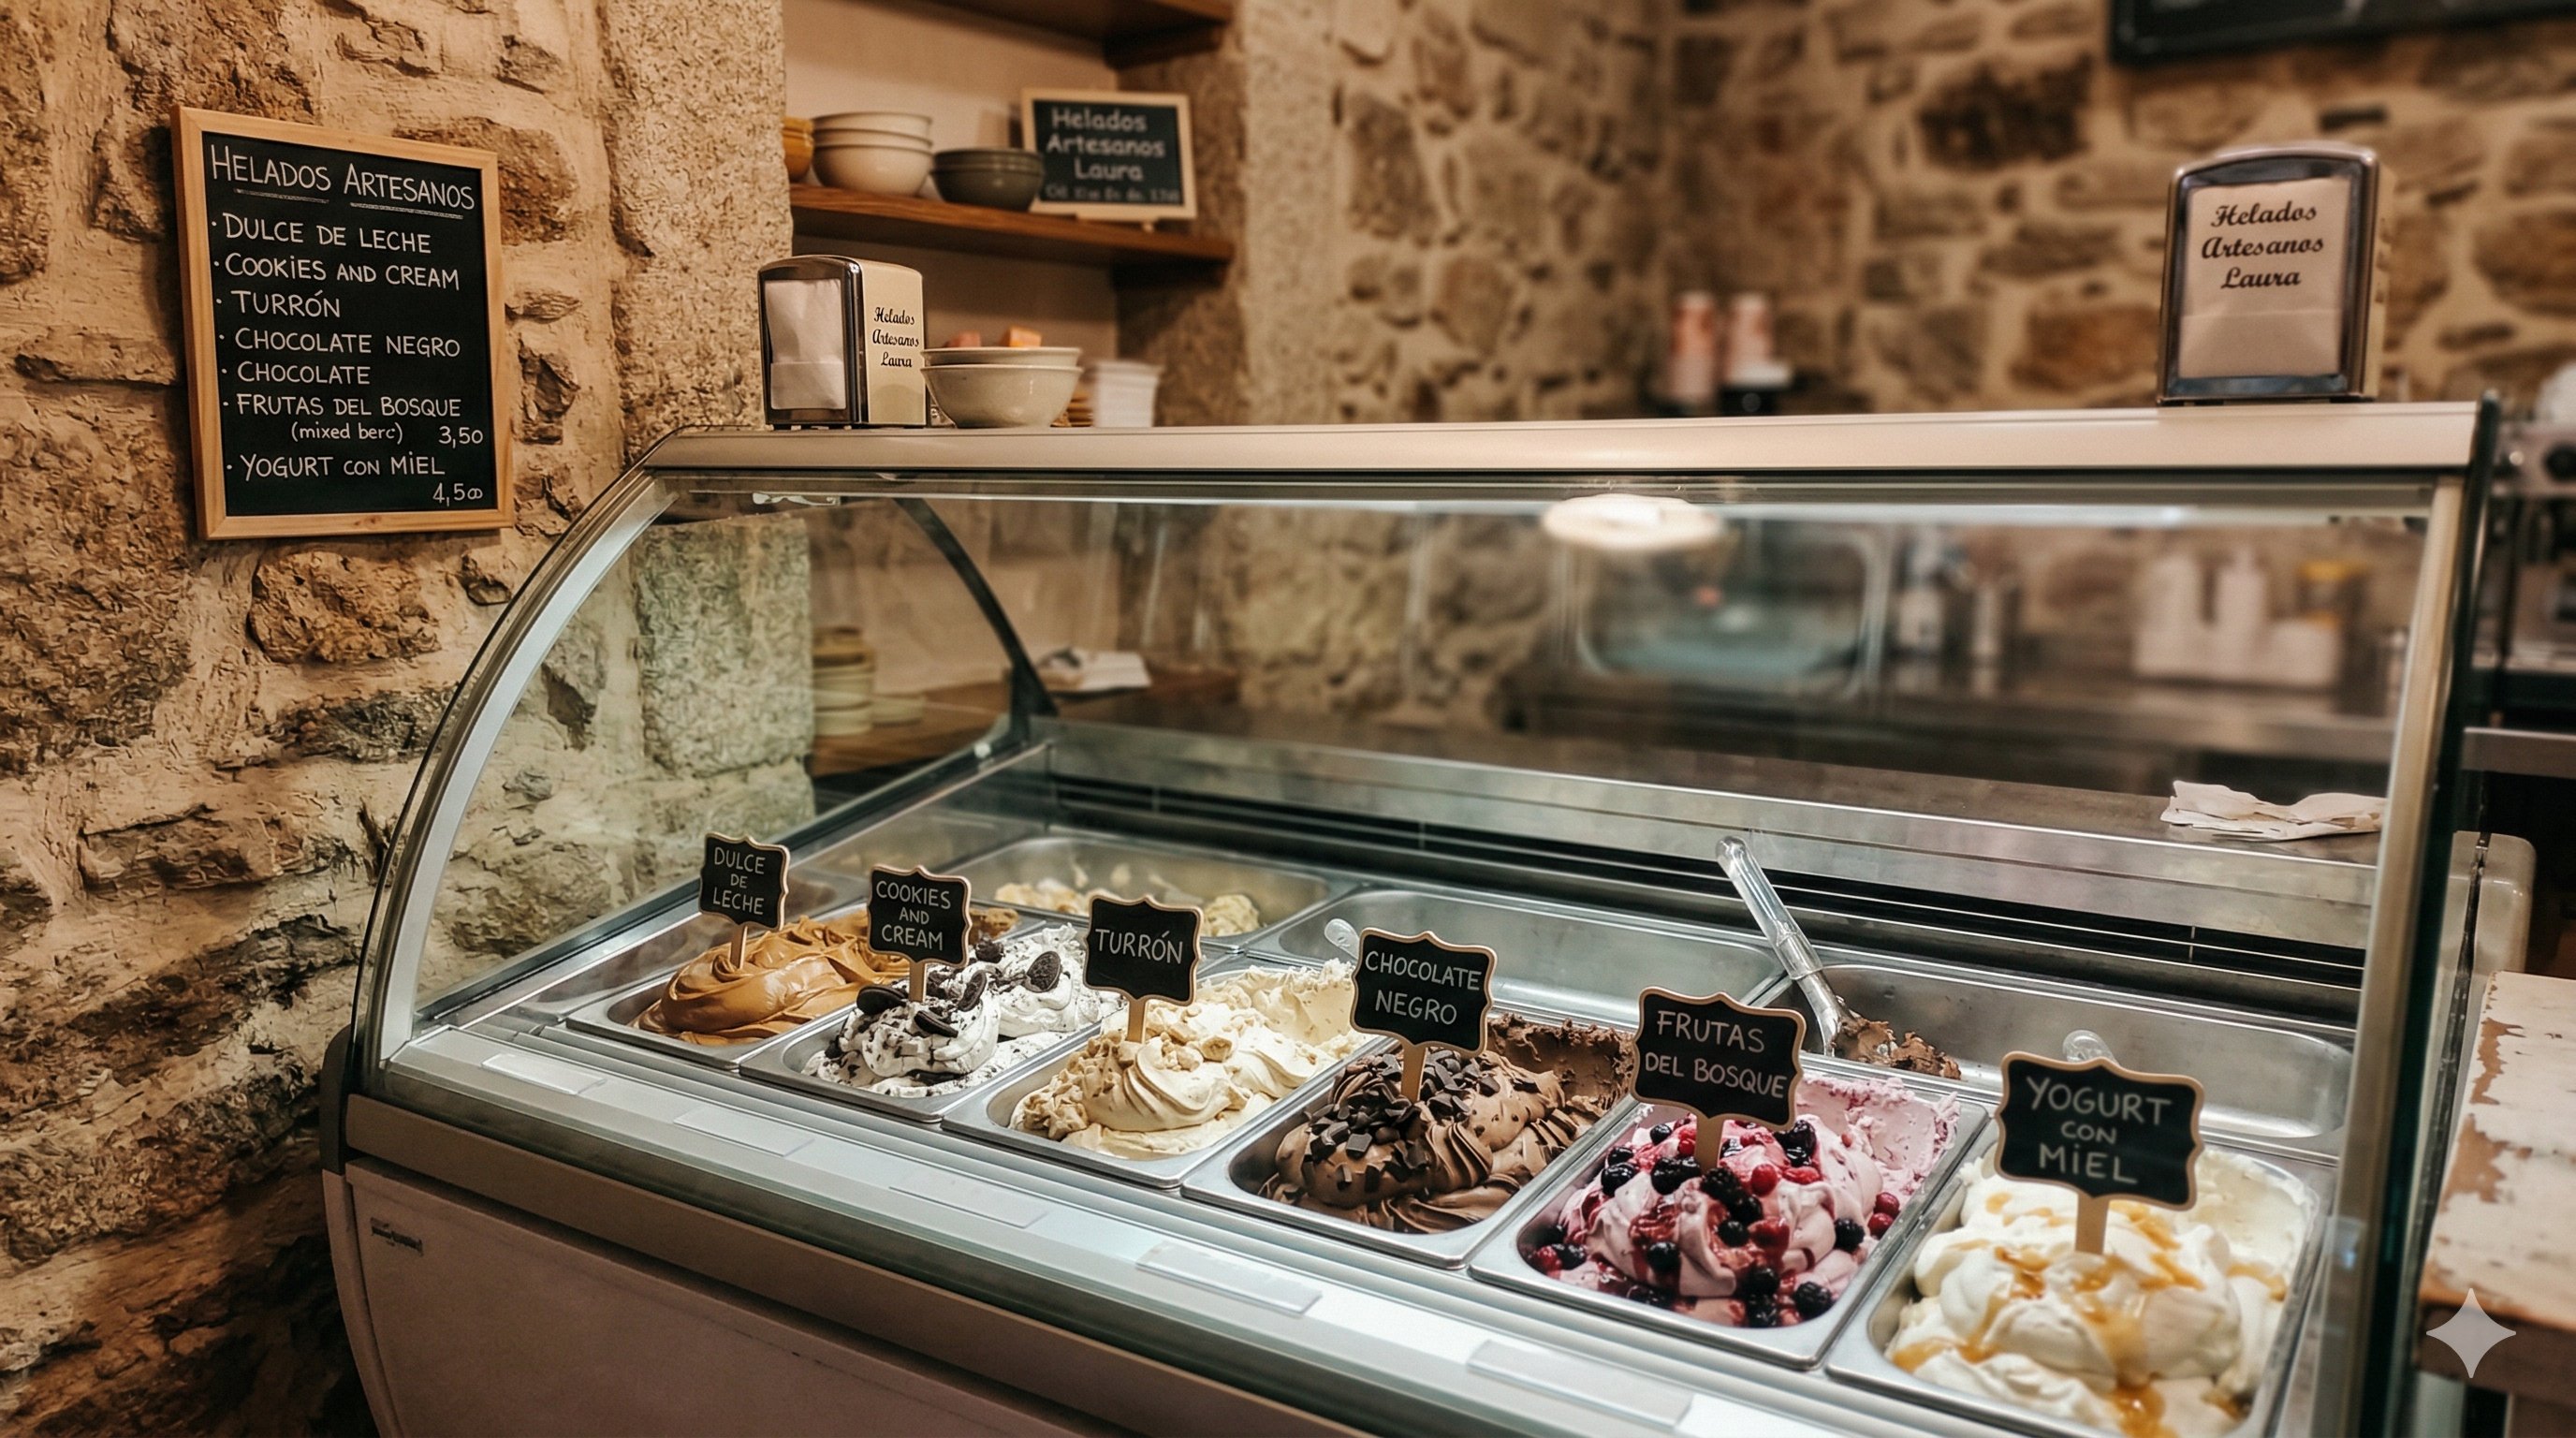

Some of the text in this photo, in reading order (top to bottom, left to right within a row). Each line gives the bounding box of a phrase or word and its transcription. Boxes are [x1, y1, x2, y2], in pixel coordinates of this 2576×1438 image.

[1051, 107, 1148, 132] Helados
[1046, 134, 1165, 157] Artesanos
[211, 145, 475, 210] HELADOS ARTESANOS
[1075, 156, 1144, 182] Laura
[2210, 200, 2318, 228] Helados
[223, 213, 432, 254] DULCE DE LECHE
[2201, 237, 2324, 259] Artesanos
[337, 263, 376, 283] AND
[386, 265, 460, 290] CREAM
[2220, 266, 2302, 289] Laura
[230, 289, 341, 318] TURRÓN
[873, 307, 915, 325] Helados
[235, 328, 461, 358] CHOCOLATE NEGRO
[238, 360, 371, 385] CHOCOLATE
[881, 351, 913, 368] Laura
[237, 393, 461, 417] FRUTAS DEL BOSQUE
[291, 421, 350, 442] (mixed
[438, 425, 484, 448] 3,50
[240, 454, 333, 481] YOGURT
[714, 846, 766, 874] DULCE
[730, 873, 748, 888] DE
[712, 887, 765, 916] LECHE
[876, 880, 951, 910] COOKIES
[899, 906, 929, 925] AND
[882, 924, 943, 951] CREAM
[1094, 928, 1184, 964] TURRÓN
[1365, 950, 1483, 991] CHOCOLATE
[1375, 989, 1458, 1025] NEGRO
[1657, 1010, 1765, 1054] FRUTAS
[1645, 1051, 1788, 1099] DEL BOSQUE
[2026, 1077, 2173, 1125] YOGURT
[2061, 1121, 2117, 1145] CON
